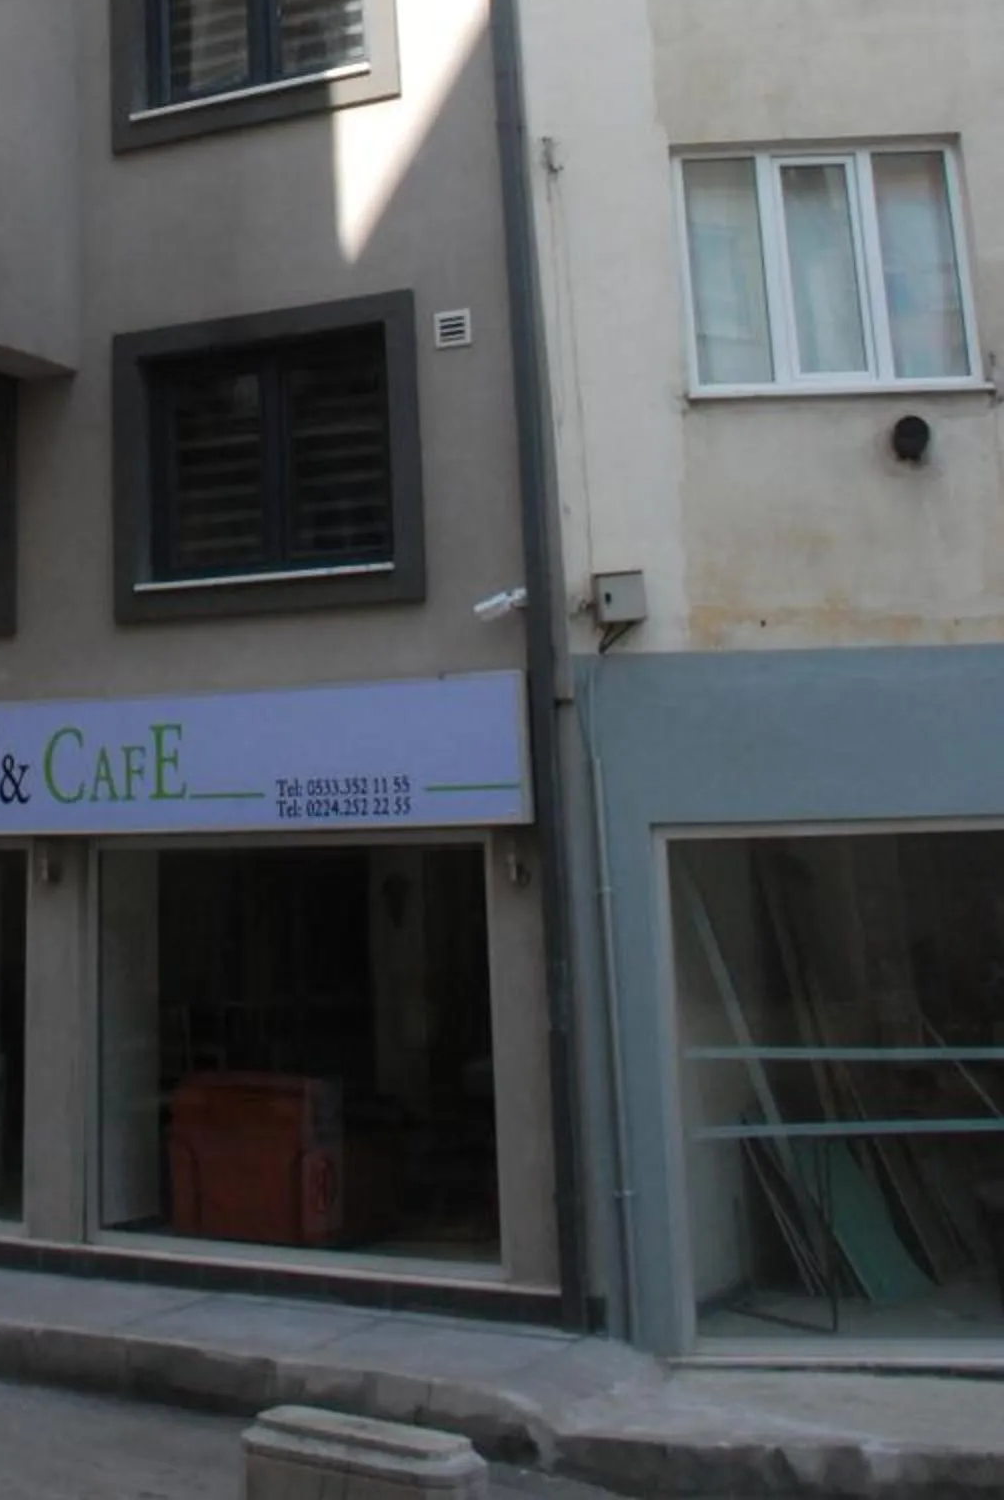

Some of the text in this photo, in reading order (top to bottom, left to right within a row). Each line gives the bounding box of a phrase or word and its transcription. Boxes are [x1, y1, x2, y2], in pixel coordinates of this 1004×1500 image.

[0, 754, 31, 804] &
[43, 724, 186, 803] CAFE
[276, 779, 303, 797] Tel:
[276, 800, 303, 818] Tel:
